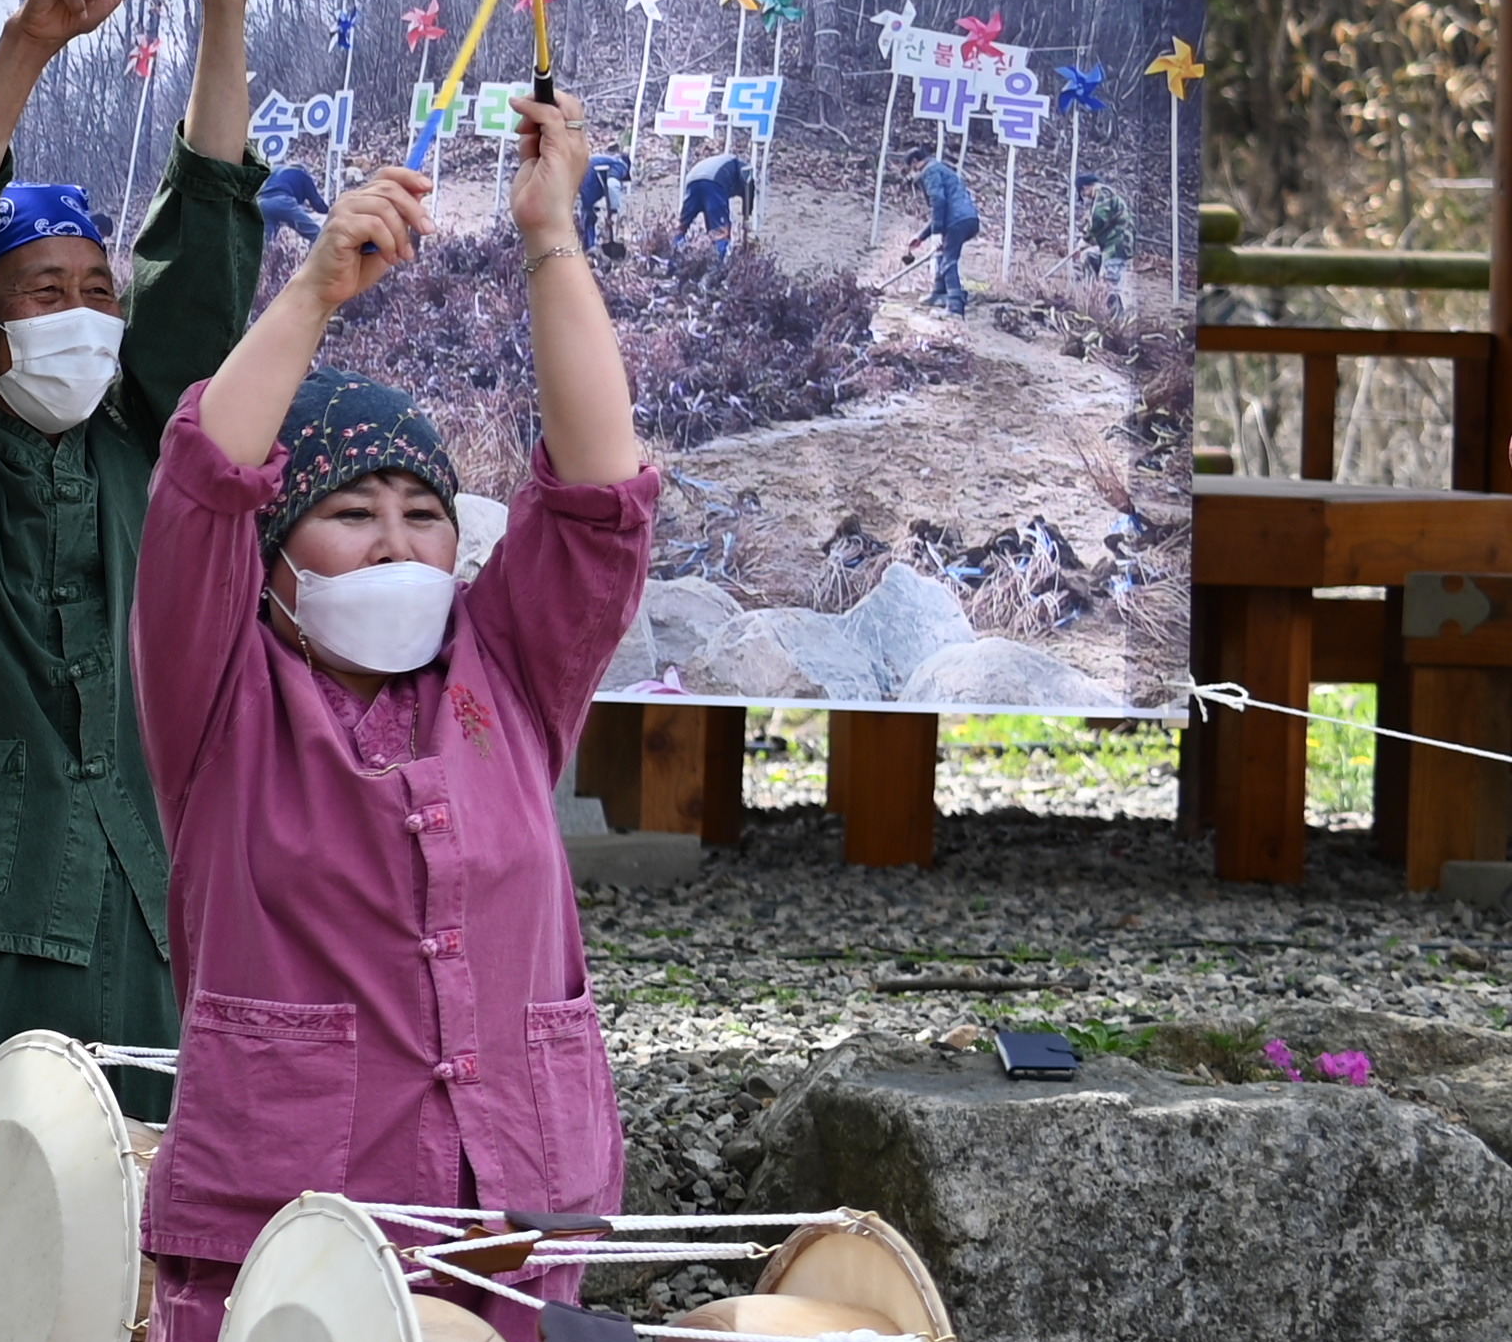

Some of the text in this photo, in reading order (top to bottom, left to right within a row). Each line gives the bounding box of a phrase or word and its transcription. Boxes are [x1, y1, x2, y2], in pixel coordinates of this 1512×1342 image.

[251, 95, 350, 158] 송이
[659, 79, 778, 138] 도덕
[918, 72, 1044, 141] 마을
